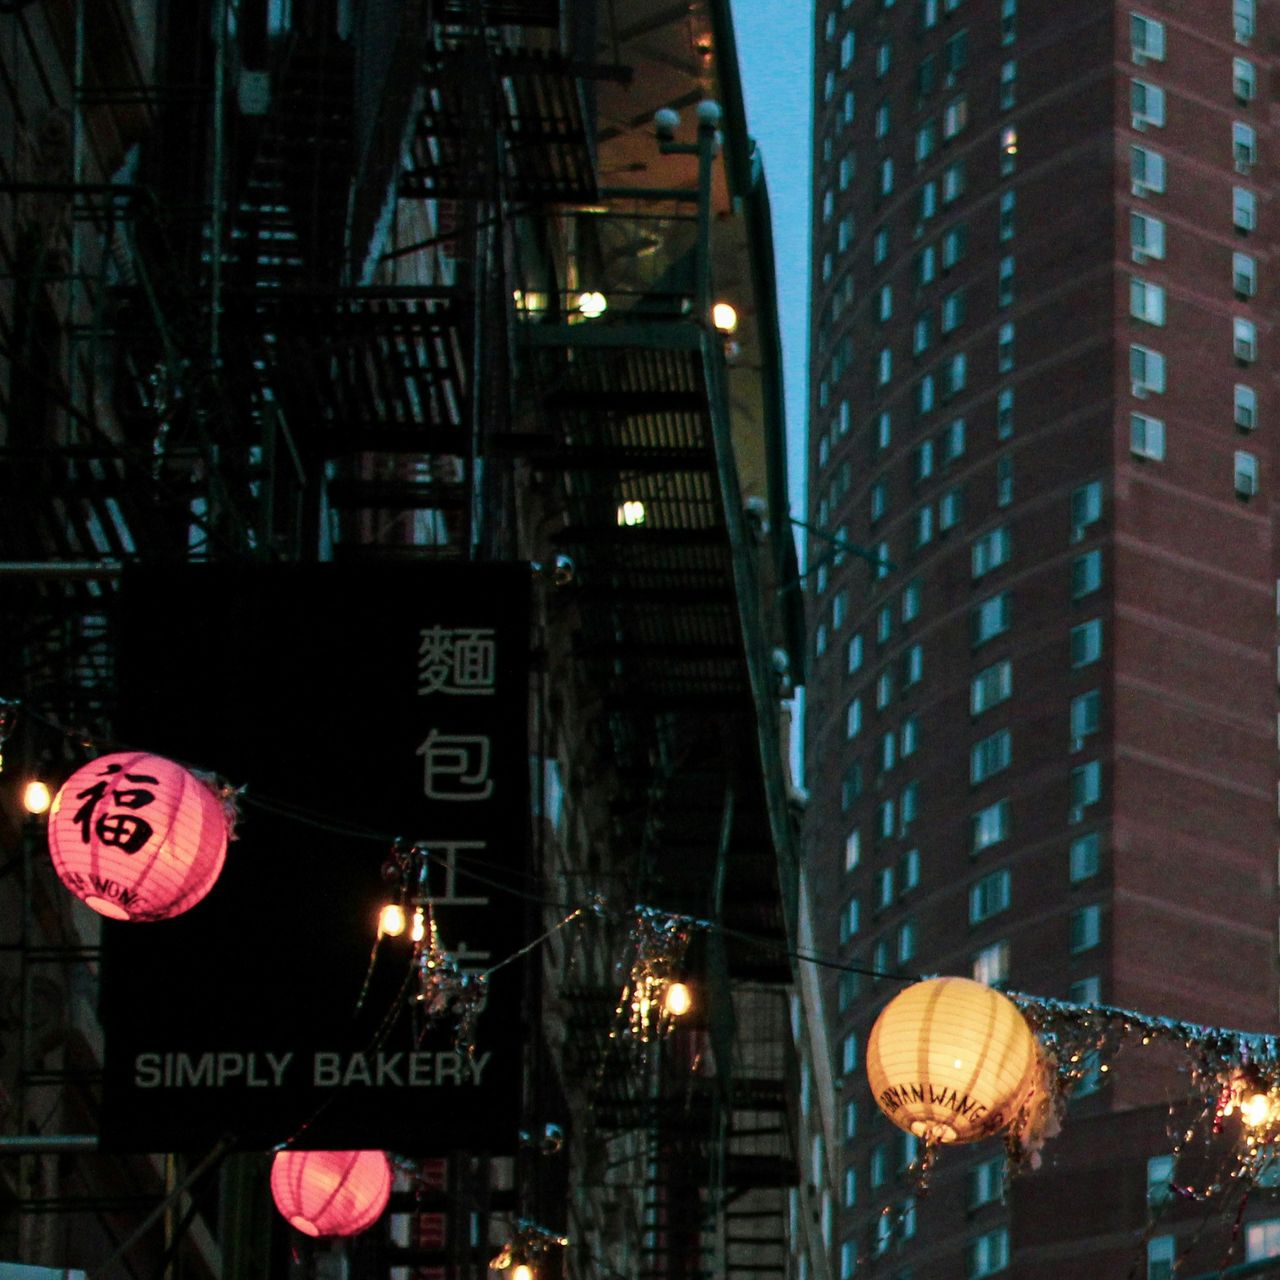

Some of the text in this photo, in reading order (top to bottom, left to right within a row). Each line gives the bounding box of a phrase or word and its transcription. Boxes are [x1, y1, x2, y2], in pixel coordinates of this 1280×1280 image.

[73, 764, 159, 854] 福
[133, 1050, 492, 1089] SIMPLY BAKERY
